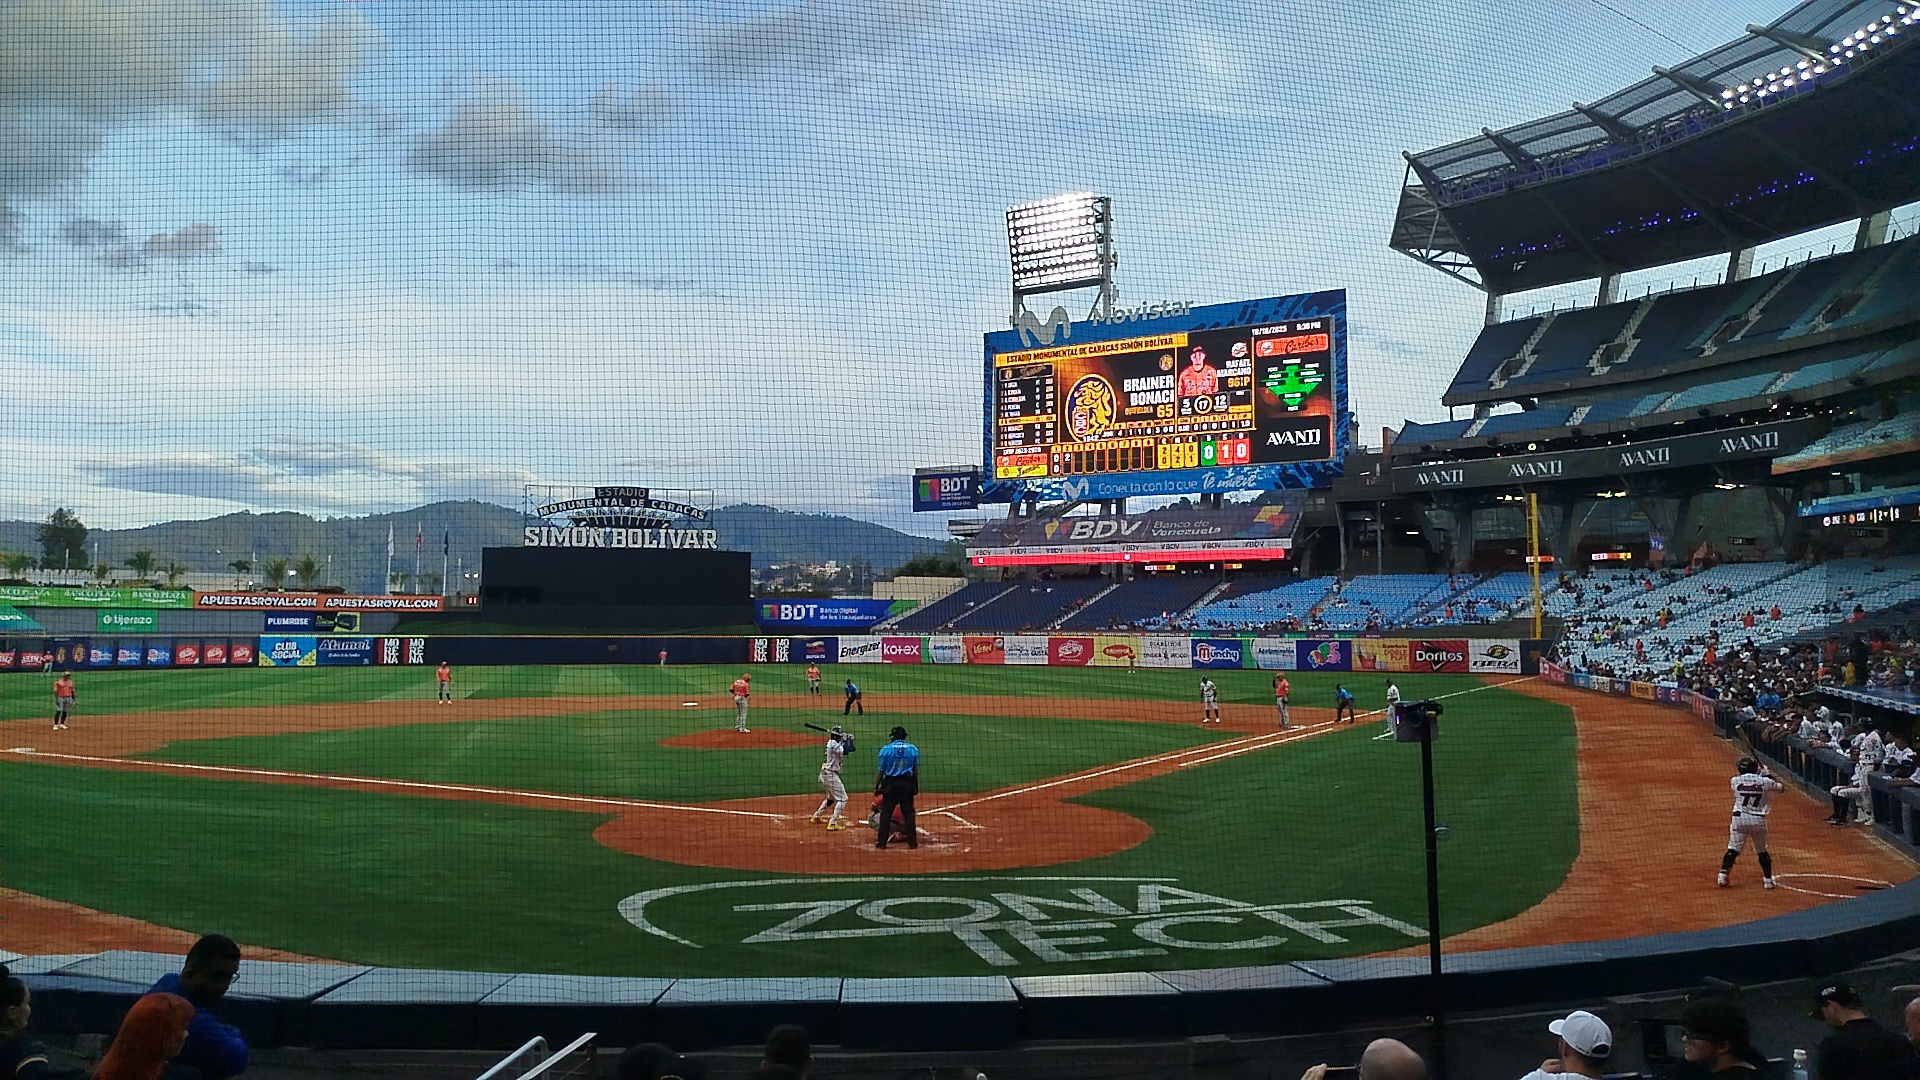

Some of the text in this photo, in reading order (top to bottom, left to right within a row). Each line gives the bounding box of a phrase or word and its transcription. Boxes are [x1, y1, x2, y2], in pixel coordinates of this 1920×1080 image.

[1092, 299, 1194, 326] Movistar
[1007, 352, 1032, 363] ESTADIO
[1033, 349, 1078, 361] MONUMENTAL
[1079, 347, 1087, 355] DE
[1088, 343, 1119, 355] CARACAS
[1144, 334, 1173, 347] BOLÍVAR
[1123, 375, 1174, 392] BRAINER
[1130, 389, 1174, 406] BONACI
[1182, 398, 1190, 408] 5
[1198, 400, 1208, 410] 17
[1214, 395, 1226, 405] 12
[1157, 404, 1173, 417] 65
[1266, 429, 1320, 446] AVANTI
[1720, 431, 1779, 453] AVANTI
[1054, 454, 1059, 462] 0
[1065, 452, 1070, 461] 2
[1203, 445, 1214, 460] 0
[1221, 444, 1229, 458] 1
[1236, 443, 1247, 458] 0
[1619, 447, 1669, 466] AVANTI
[1054, 464, 1059, 472] 0
[1509, 461, 1562, 477] AVANTI
[940, 477, 970, 492] BDT
[1202, 471, 1215, 489] Te
[1415, 469, 1463, 485] AVANTI
[598, 488, 646, 497] ESTADIO
[1099, 480, 1198, 495] Conecta con lo que
[539, 498, 706, 520] MONUMENTAL DE CARACAS
[1070, 519, 1142, 540] BDV
[1152, 526, 1221, 537] Venezuela
[1153, 519, 1209, 529] Banco de
[524, 522, 718, 549] SIMÓN BOLÍVAR
[132, 590, 186, 599] BANCO PLAZA
[200, 595, 317, 607] APUESTASROYAL.COM
[326, 597, 438, 608] APUESTASROYAL.COM
[781, 605, 818, 620] BDT
[267, 617, 309, 625] PLUMROSE
[275, 642, 297, 651] CLUB
[319, 639, 371, 650] Atamel
[840, 641, 881, 658] Energizer
[883, 642, 919, 656] kotex
[272, 650, 301, 659] SOCIAL
[1193, 643, 1240, 662] Munchy
[1416, 650, 1463, 661] Doritos
[1740, 793, 1762, 807] 77
[733, 886, 1252, 944] ZONA
[950, 899, 1430, 966] TECH
